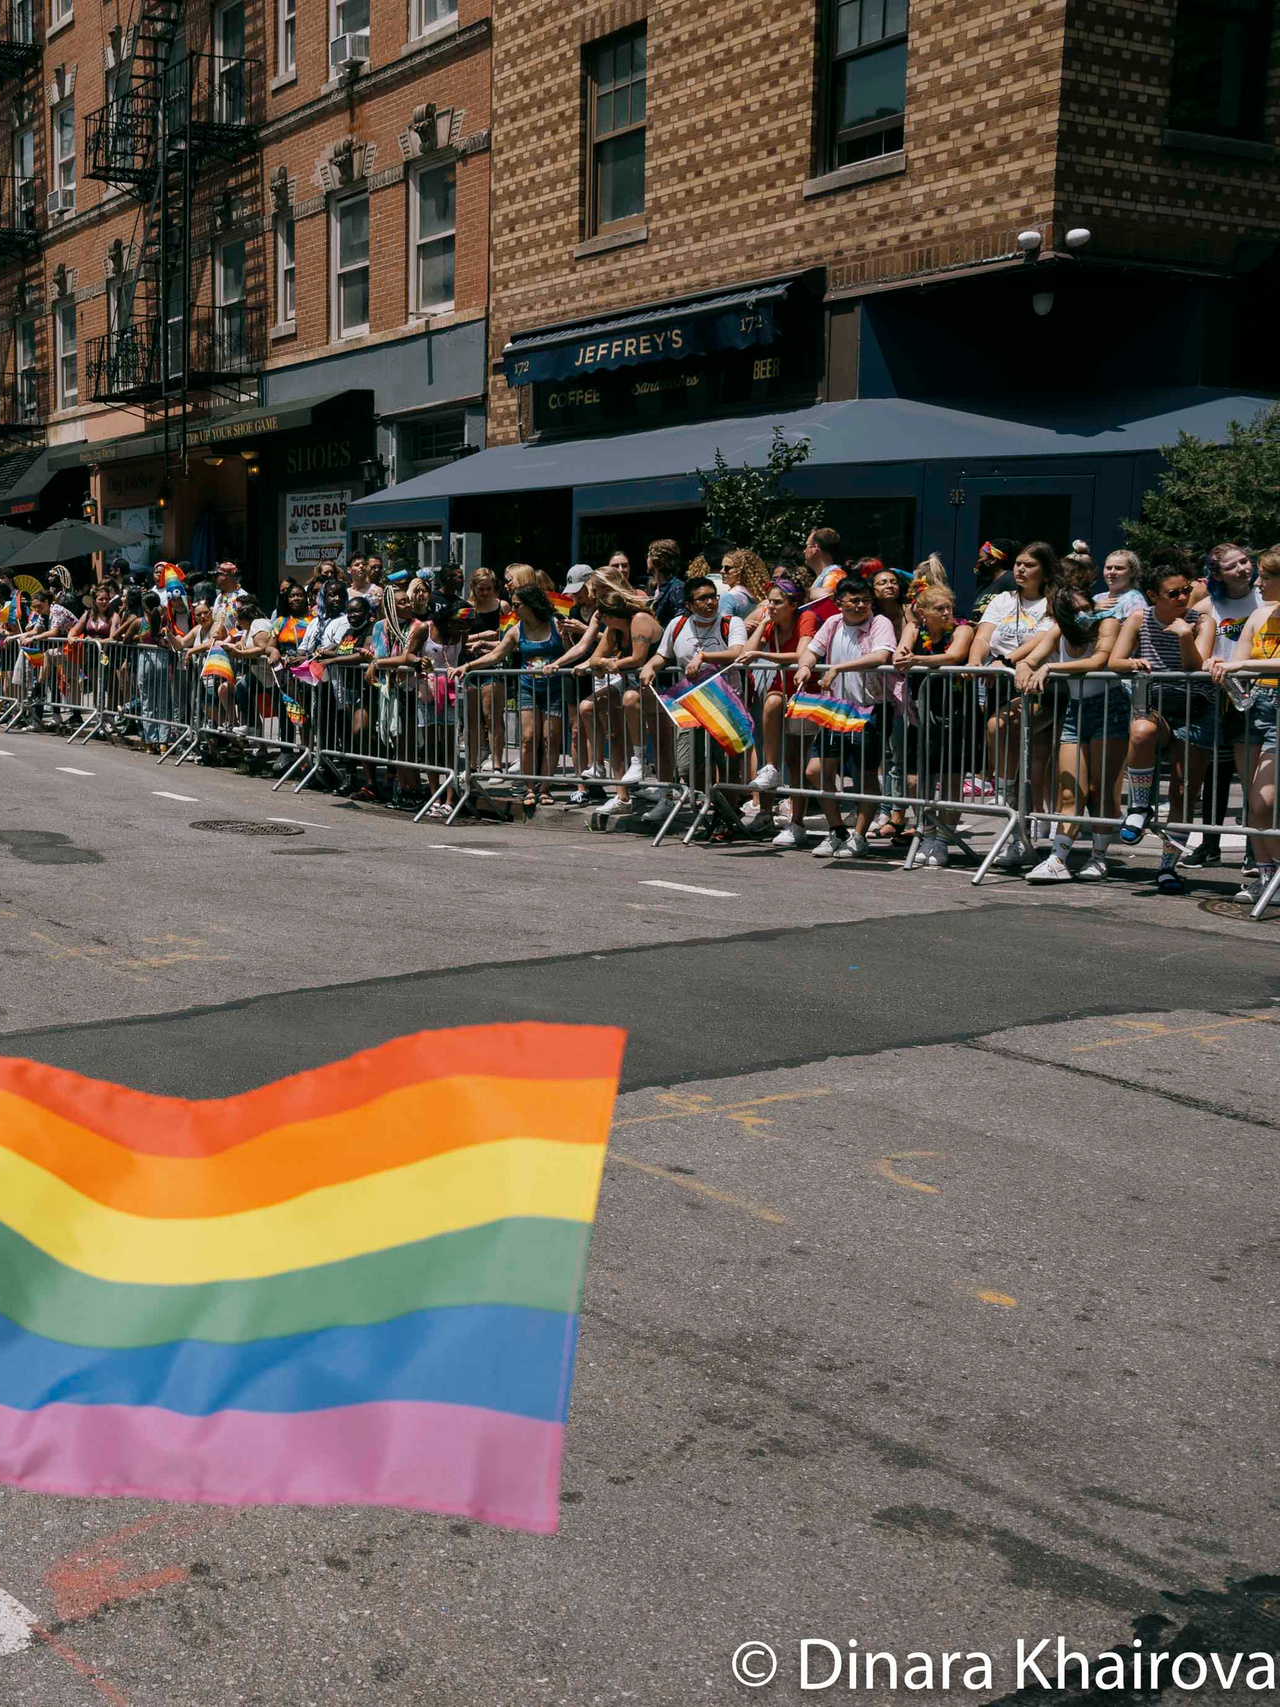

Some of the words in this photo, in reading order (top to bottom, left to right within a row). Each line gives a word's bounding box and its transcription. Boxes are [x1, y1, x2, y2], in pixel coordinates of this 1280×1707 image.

[740, 315, 762, 334] 172
[574, 329, 683, 366] JEFFREY'S
[514, 360, 530, 377] 172
[753, 357, 782, 380] BEER
[548, 388, 600, 410] COFFEE
[211, 425, 232, 441] YOUR
[233, 421, 253, 438] SHOE
[255, 416, 278, 432] GAME
[286, 440, 352, 474] SHOES
[291, 504, 320, 517] JUICE
[324, 502, 347, 516] BAR
[312, 519, 336, 532] DELI
[297, 547, 320, 559] COMING
[321, 547, 339, 559] SOON
